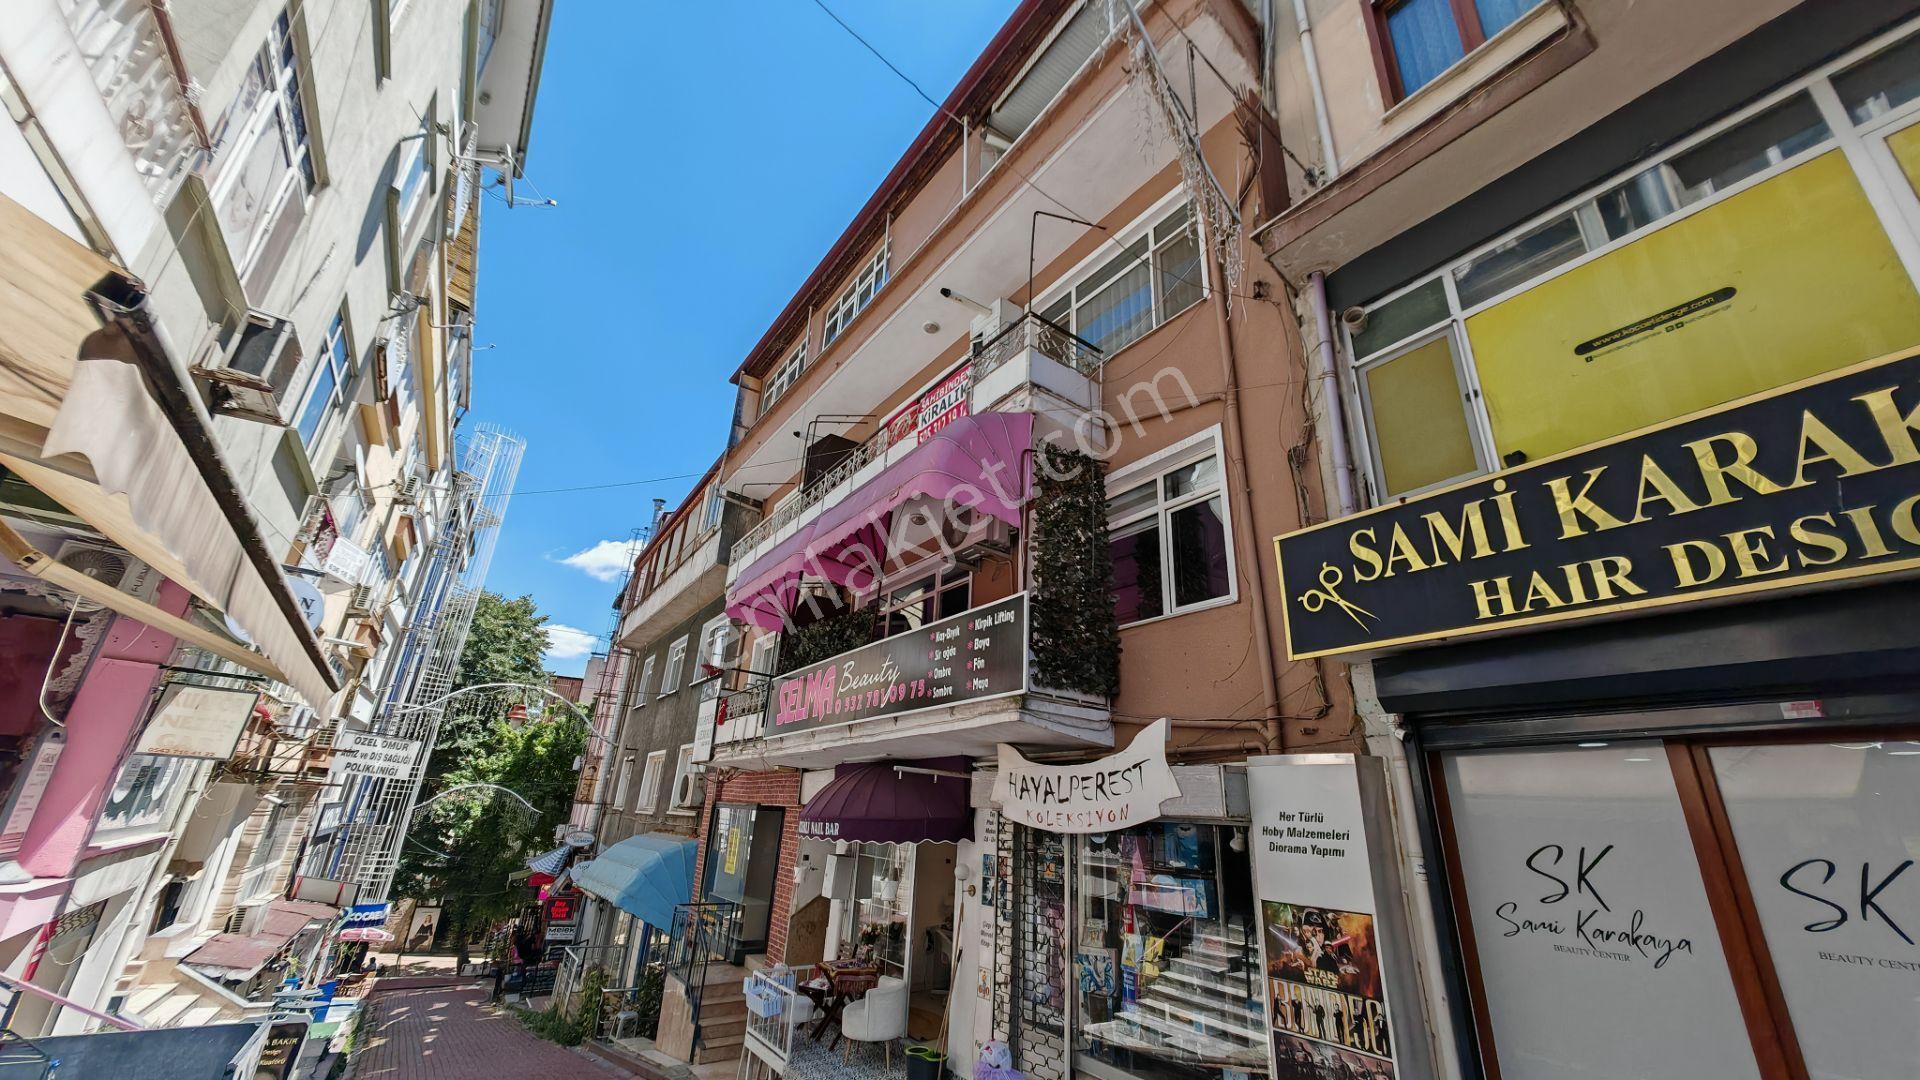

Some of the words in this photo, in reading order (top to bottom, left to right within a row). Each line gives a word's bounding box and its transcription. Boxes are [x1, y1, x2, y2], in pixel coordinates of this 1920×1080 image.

[1349, 479, 1532, 584] SAMİ
[1468, 556, 1648, 620] HAIR
[994, 609, 1015, 623] Lifting
[974, 637, 990, 650] Boya
[837, 653, 901, 708] Beauty
[889, 682, 906, 703] 09
[909, 678, 926, 699] 75
[776, 664, 837, 726] SELMA
[1009, 758, 1151, 803] HAYALPEREST
[1279, 811, 1295, 821] Her
[1298, 812, 1324, 823] Türlü
[825, 822, 840, 836] BAR
[1262, 825, 1284, 839] Hoby
[1286, 826, 1350, 840] Malzemeleri
[1269, 841, 1308, 854] Diorama
[1310, 844, 1345, 858] Yapımı
[1526, 844, 1614, 912] SK
[1780, 858, 1915, 946] SK
[1496, 901, 1566, 938] Sami
[1576, 909, 1693, 969] Karakaya
[1553, 943, 1593, 956] BEAUTY
[1593, 948, 1632, 962] CENTER
[1818, 951, 1875, 966] BEAUTY
[1879, 958, 1920, 972] CENT
[1304, 966, 1338, 980] STAR
[1304, 973, 1339, 989] WARS
